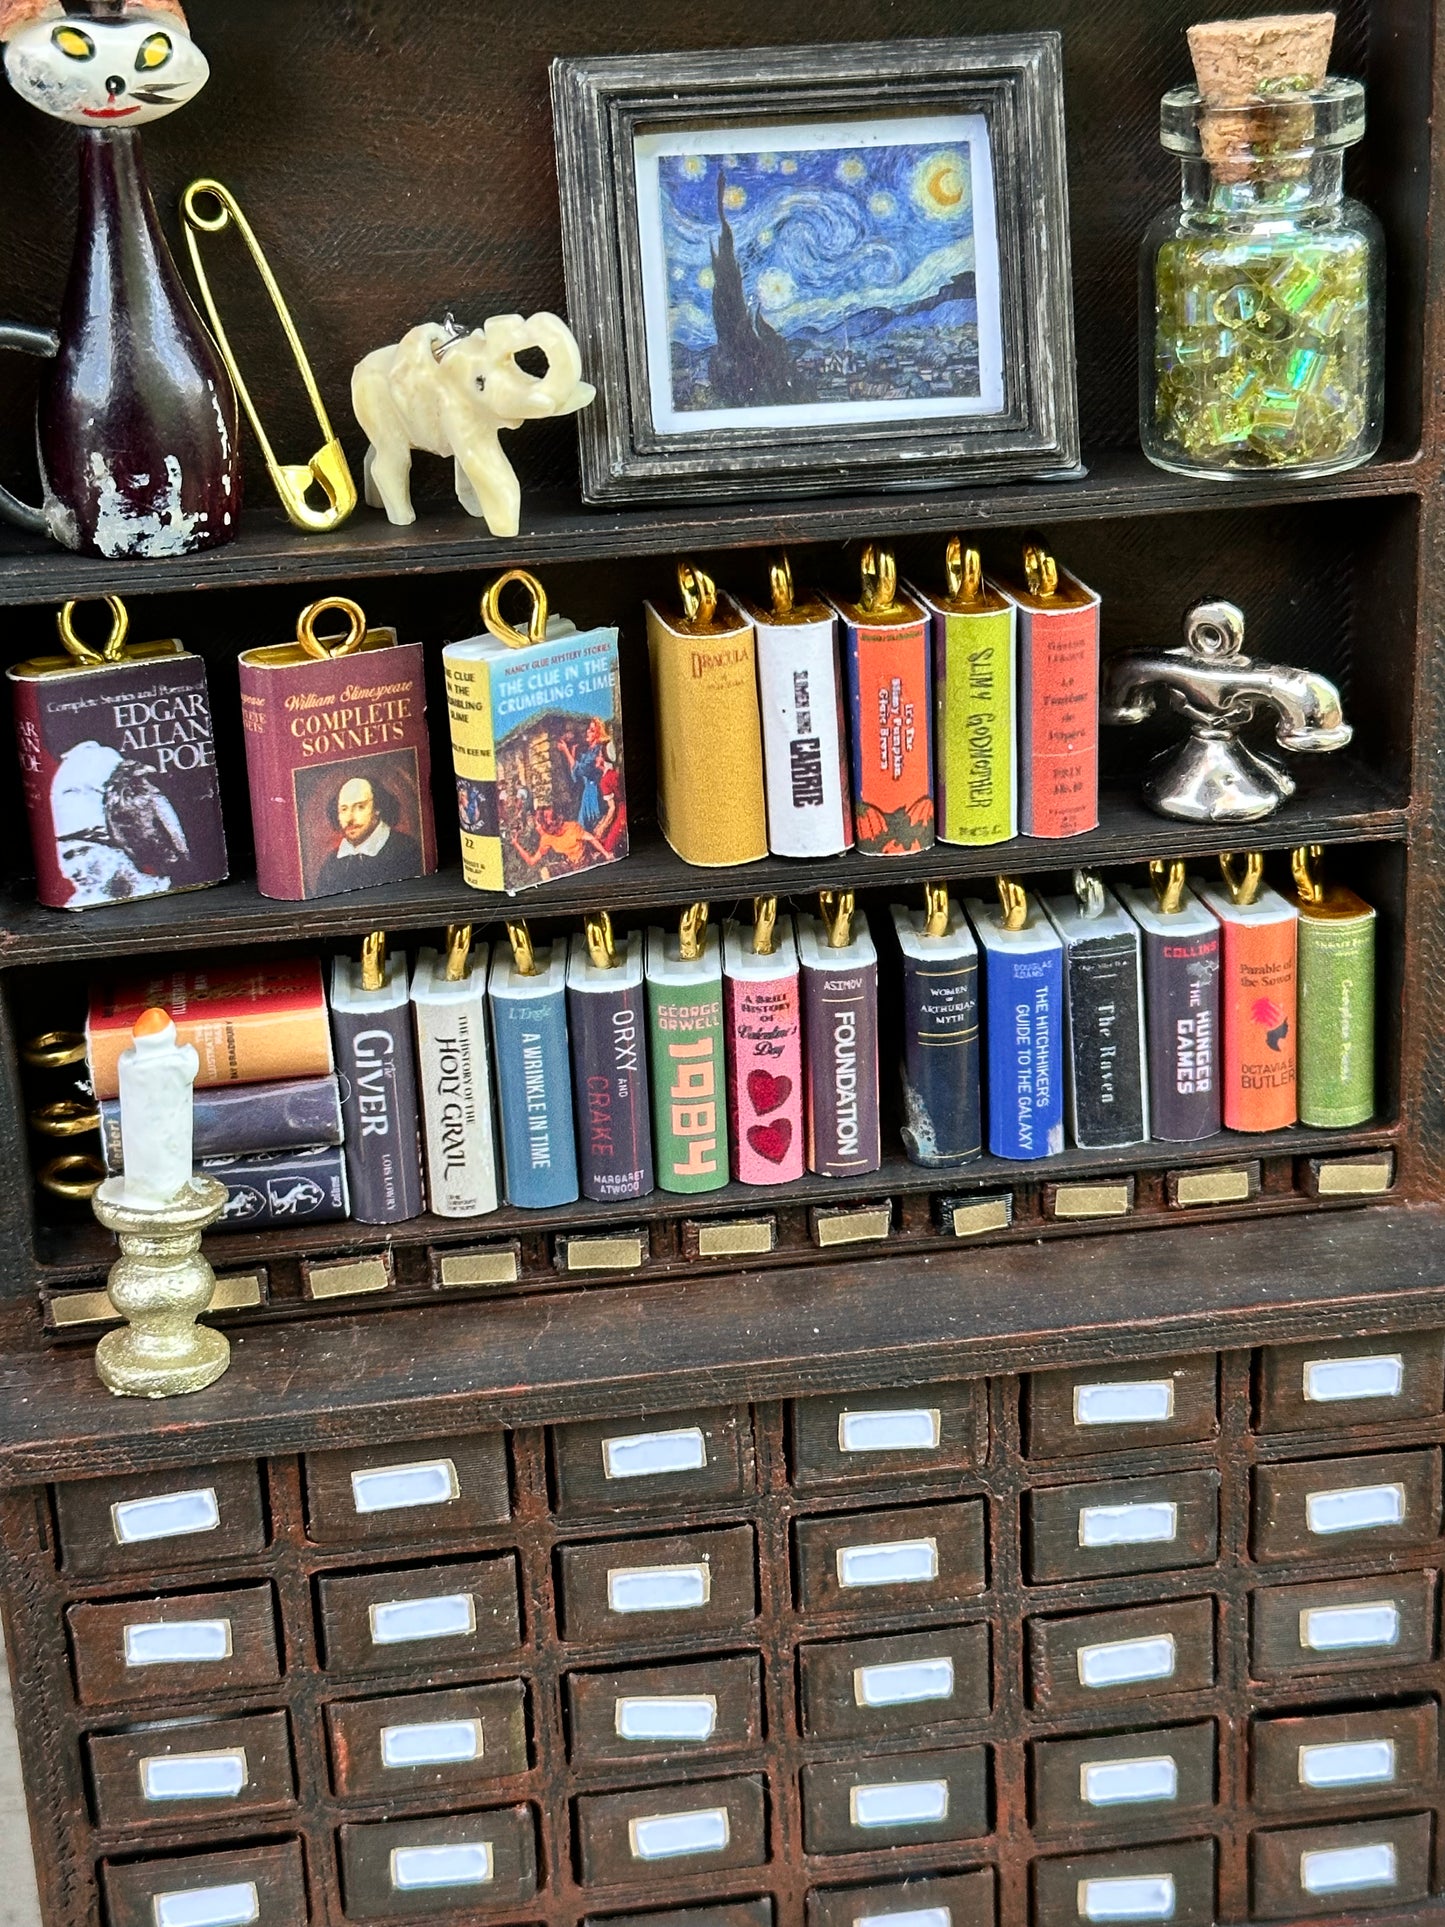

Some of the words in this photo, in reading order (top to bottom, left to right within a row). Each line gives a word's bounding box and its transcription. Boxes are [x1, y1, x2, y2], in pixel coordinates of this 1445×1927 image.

[505, 663, 530, 676] NANCY
[531, 657, 550, 669] GLUE
[551, 650, 582, 665] MYSTERY
[583, 643, 611, 656] STORIES
[691, 647, 749, 678] DRACULA
[967, 648, 994, 700] SLIMY
[453, 671, 476, 682] CLUE
[454, 684, 470, 697] THE
[498, 678, 524, 698] THE
[527, 669, 560, 690] CLUE
[565, 664, 579, 681] IN
[584, 657, 609, 675] THE
[46, 697, 99, 713] Complete
[137, 686, 157, 699] and
[284, 692, 336, 712] William
[340, 681, 413, 702] Slimespeare
[498, 684, 574, 716] CRUMBLING
[579, 671, 616, 694] SLIME
[113, 694, 209, 728] EDGAR
[290, 698, 412, 737] COMPLETE
[120, 716, 211, 752] ALLAN
[302, 721, 404, 757] SONNETS
[157, 741, 216, 773] POE
[467, 748, 492, 757] KEENE
[790, 737, 824, 808] CARRIE
[1163, 940, 1217, 959] COLLINS
[1240, 962, 1282, 975] Parable
[1241, 976, 1258, 987] the
[823, 978, 863, 991] ASIMOV
[929, 985, 968, 997] WOMEN
[1035, 985, 1049, 1013] THE
[657, 1001, 720, 1019] GEORGE
[658, 1013, 720, 1031] ORWELL
[920, 999, 976, 1015] ARTHURIAN
[936, 1014, 964, 1024] MYTH
[1098, 1001, 1115, 1038] The
[458, 1015, 470, 1036] THE
[522, 1032, 541, 1044] A
[1016, 1004, 1031, 1045] GUIDE
[1190, 981, 1200, 1007] THE
[1196, 1010, 1212, 1092] HUNGER
[611, 1009, 638, 1072] ORXY
[753, 1040, 785, 1058] Day
[434, 1036, 462, 1096] HOLY
[459, 1038, 474, 1086] HISTORY
[1017, 1049, 1032, 1065] TO
[1036, 1016, 1050, 1108] HITCHHIKER'S
[1177, 1018, 1195, 1095] GAMES
[1242, 1060, 1287, 1074] OCTAVIA
[353, 1029, 395, 1137] GIVER
[523, 1046, 546, 1112] WRINKLE
[617, 1077, 628, 1099] AND
[834, 1010, 859, 1156] FOUNDATION
[1017, 1068, 1033, 1094] THE
[1100, 1045, 1116, 1104] Raven
[1242, 1070, 1295, 1089] BUTLER
[464, 1087, 475, 1102] OF
[668, 1036, 717, 1176] 1984
[465, 1103, 476, 1126] THE
[528, 1115, 548, 1131] IN
[586, 1075, 614, 1157] CRAKE
[1018, 1096, 1033, 1150] GALAXY
[441, 1102, 466, 1181] GRAIL
[530, 1133, 551, 1169] TIME
[381, 1153, 393, 1176] LOIS
[593, 1170, 644, 1184] MARGARET
[384, 1177, 396, 1211] LOWRY
[600, 1181, 639, 1194] ATWOOD
